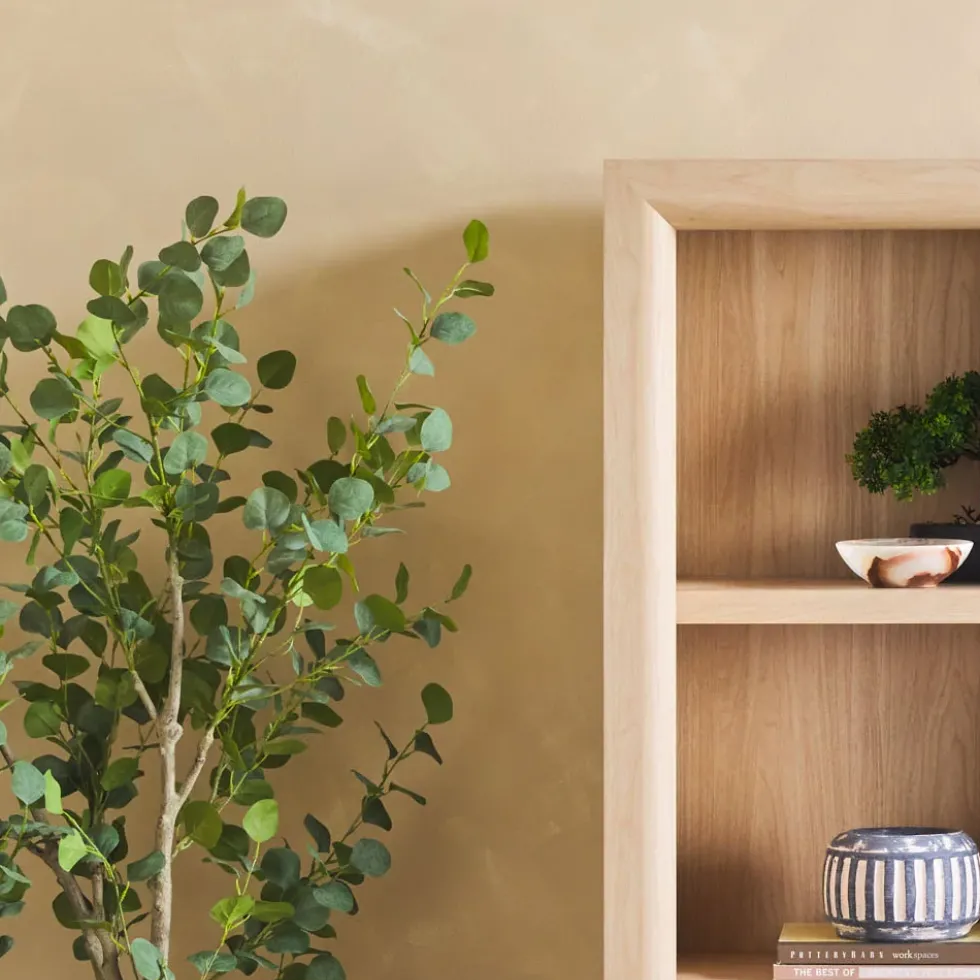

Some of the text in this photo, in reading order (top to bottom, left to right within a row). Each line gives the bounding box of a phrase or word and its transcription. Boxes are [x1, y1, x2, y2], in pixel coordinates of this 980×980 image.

[793, 967, 855, 977] THE BEST OF
